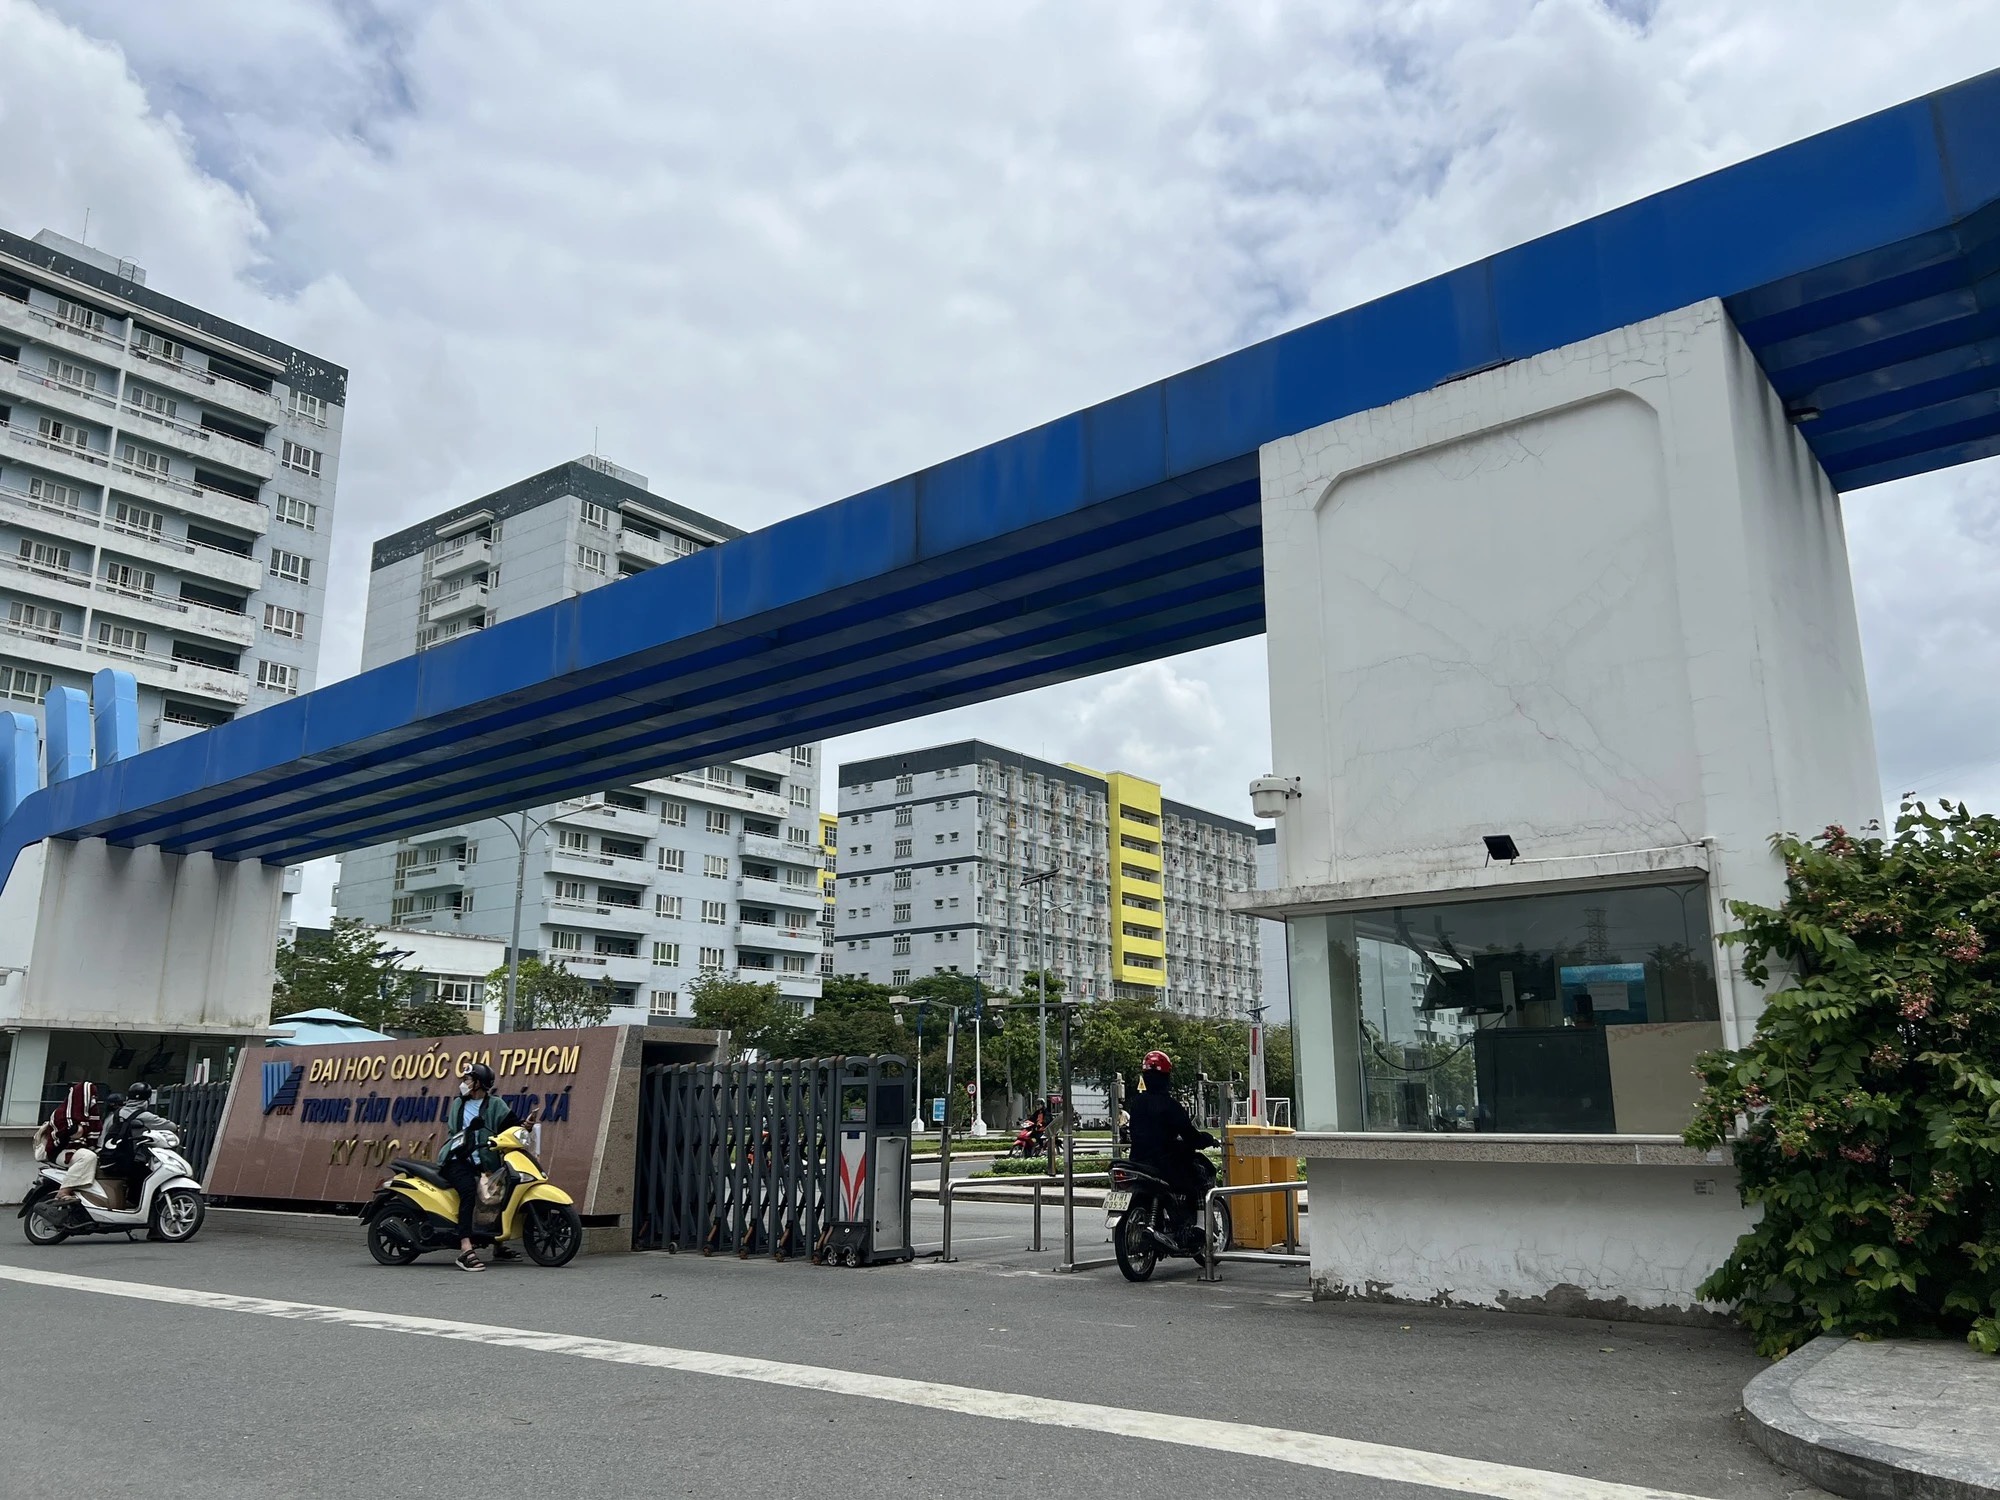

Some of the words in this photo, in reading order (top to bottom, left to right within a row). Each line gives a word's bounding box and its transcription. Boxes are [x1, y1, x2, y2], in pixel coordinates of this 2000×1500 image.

[309, 1057, 342, 1087] ĐẠI
[343, 1055, 387, 1087] HỌC
[390, 1042, 451, 1080] QUỐC
[499, 1045, 581, 1076] TPHCM
[300, 1097, 352, 1123] TRUNG
[353, 1091, 391, 1123] TÂM
[391, 1086, 440, 1126] QUẢN
[539, 1085, 572, 1122] XÁ
[329, 1133, 359, 1167] KÝ
[363, 1134, 401, 1167] TÚC
